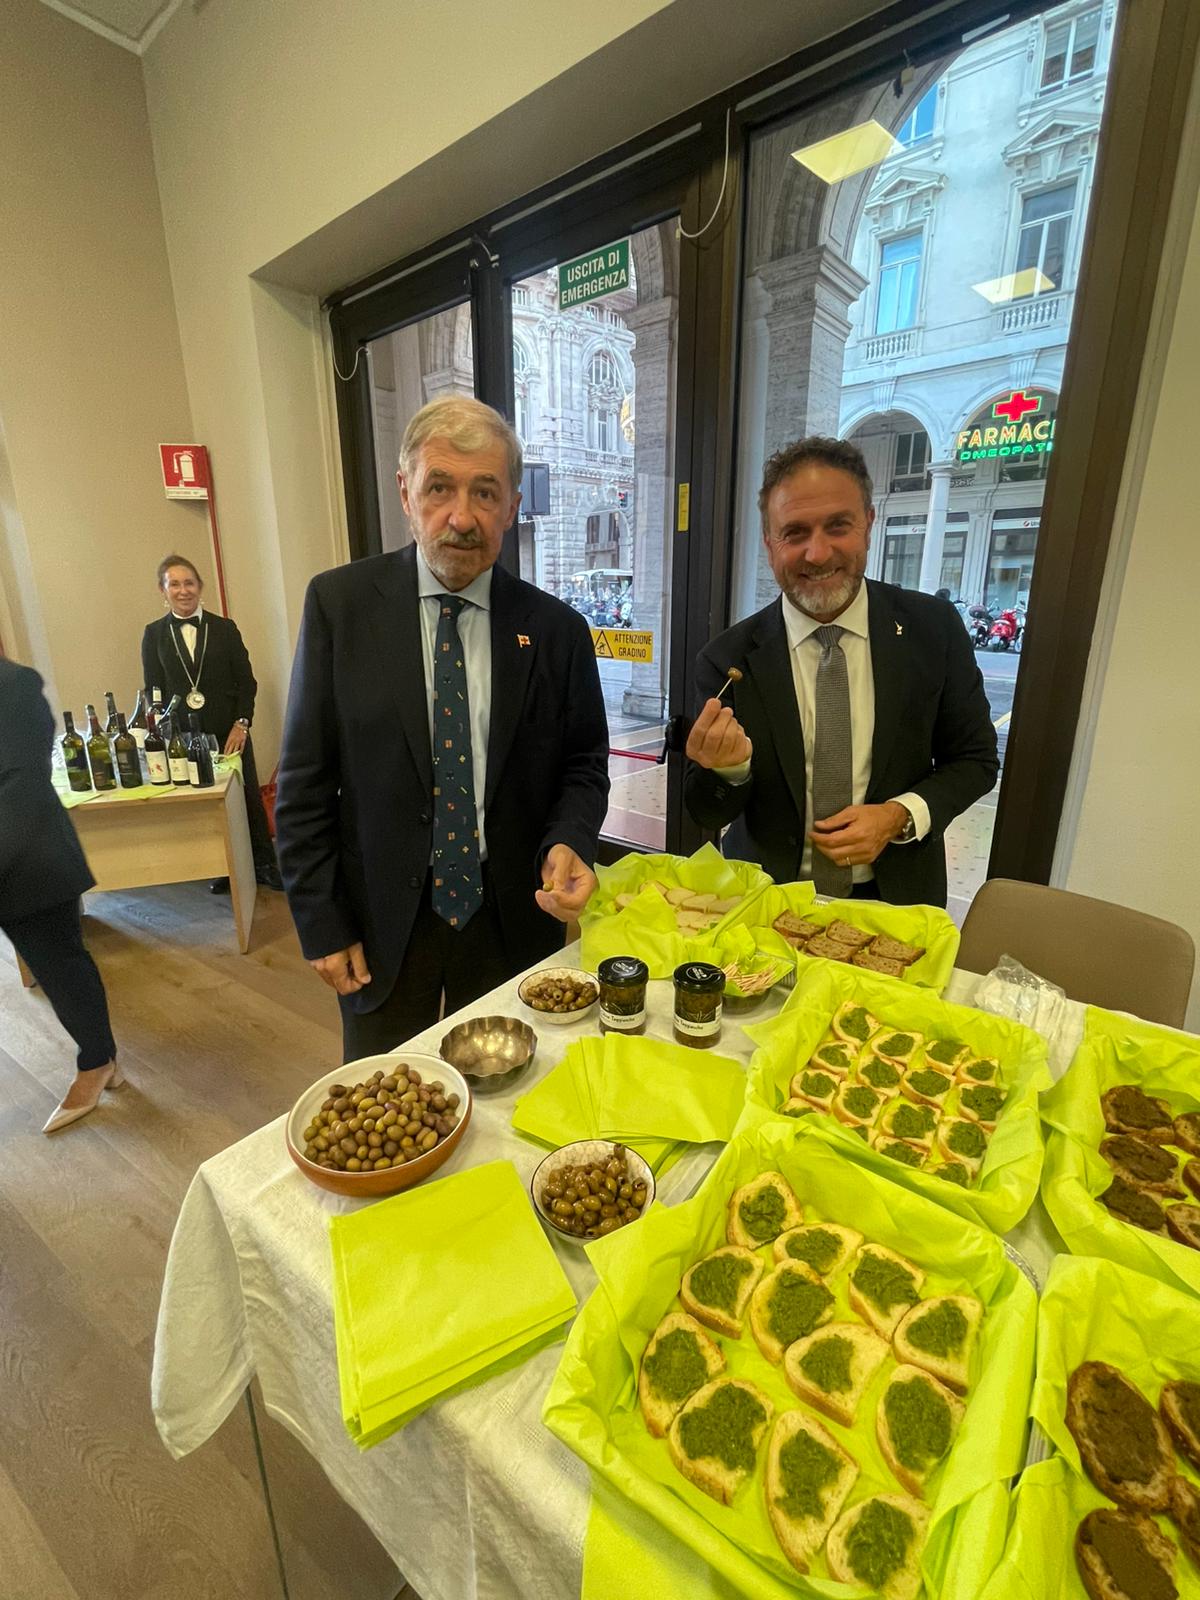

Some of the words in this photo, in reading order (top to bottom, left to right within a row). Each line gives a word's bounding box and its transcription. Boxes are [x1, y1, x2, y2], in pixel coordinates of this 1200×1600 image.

[567, 256, 605, 283] USCITA
[608, 249, 620, 267] DI
[561, 268, 627, 305] EMERGENZA
[614, 633, 653, 645] ATTENZIONE
[618, 647, 647, 658] GRADINO
